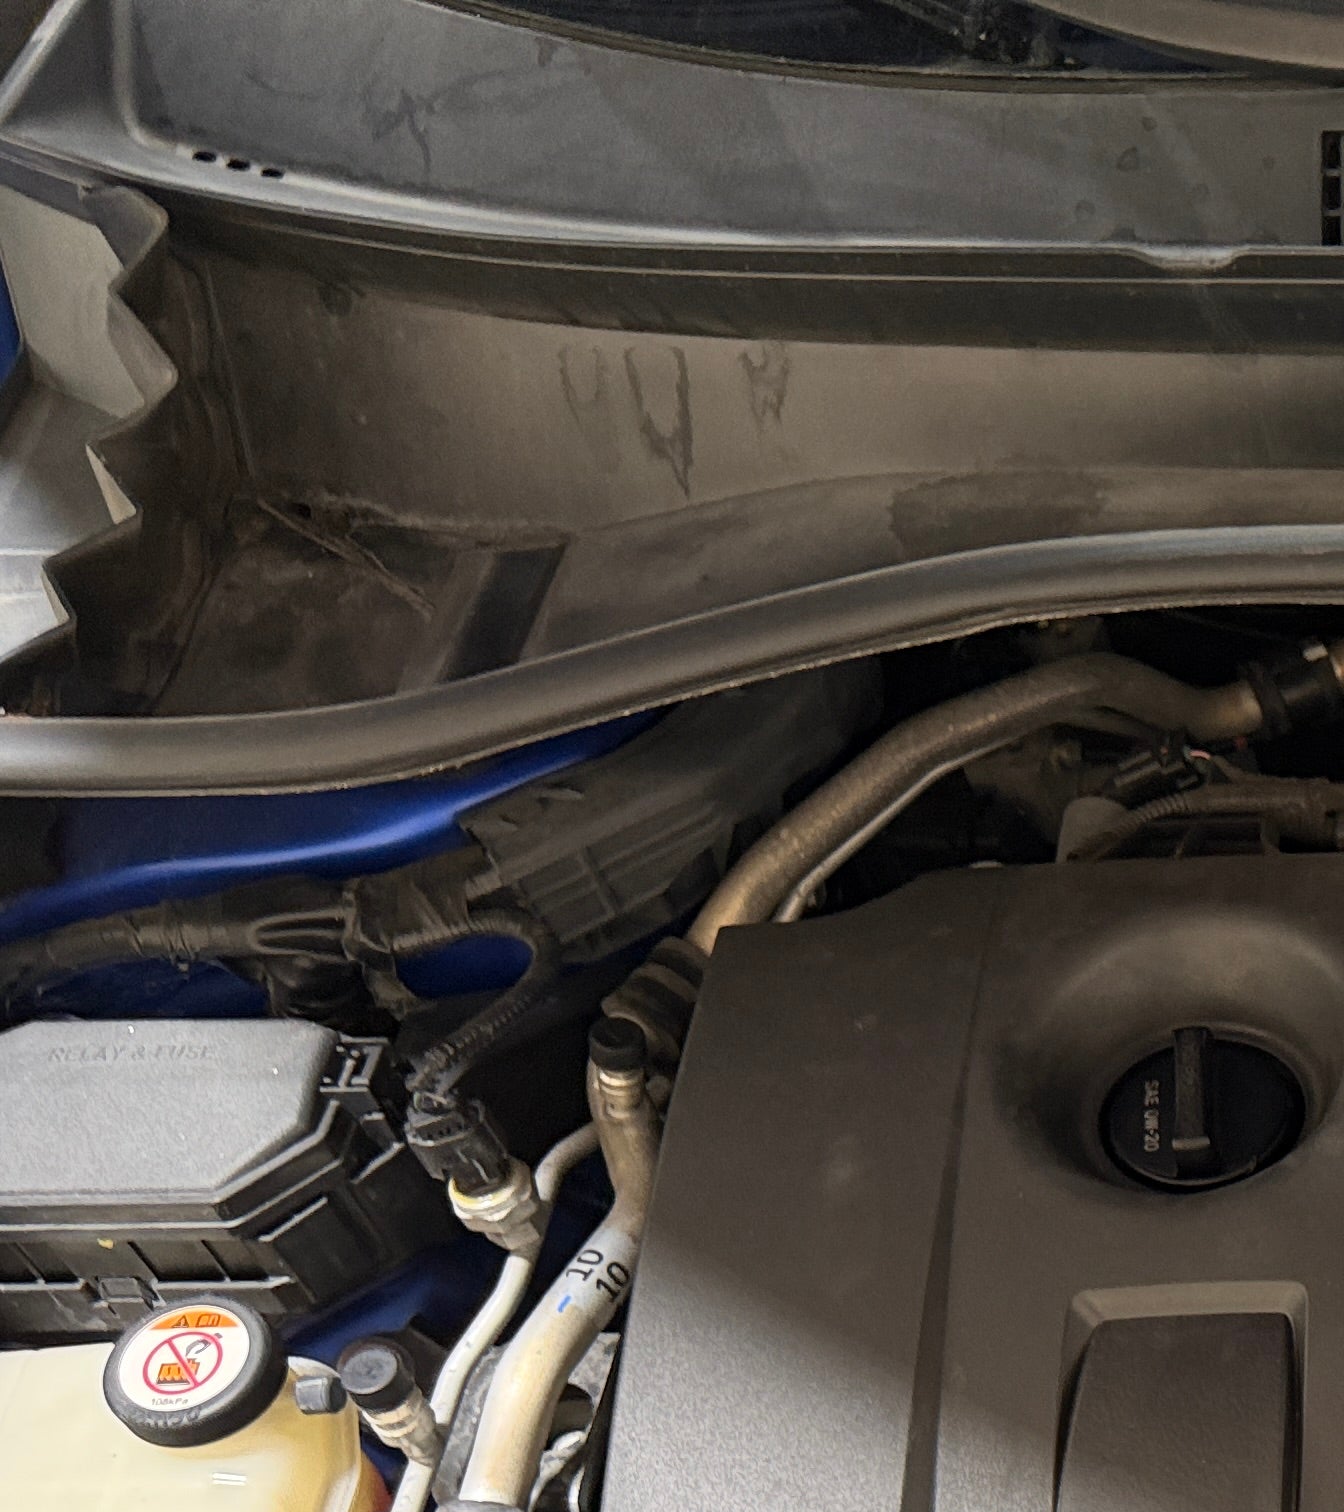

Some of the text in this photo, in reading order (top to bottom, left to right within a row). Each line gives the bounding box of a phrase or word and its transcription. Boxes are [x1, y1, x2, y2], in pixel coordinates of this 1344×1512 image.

[49, 1045, 126, 1062] RELAY
[154, 1044, 215, 1061] FUSE
[1143, 1080, 1160, 1152] SAE 0W-20
